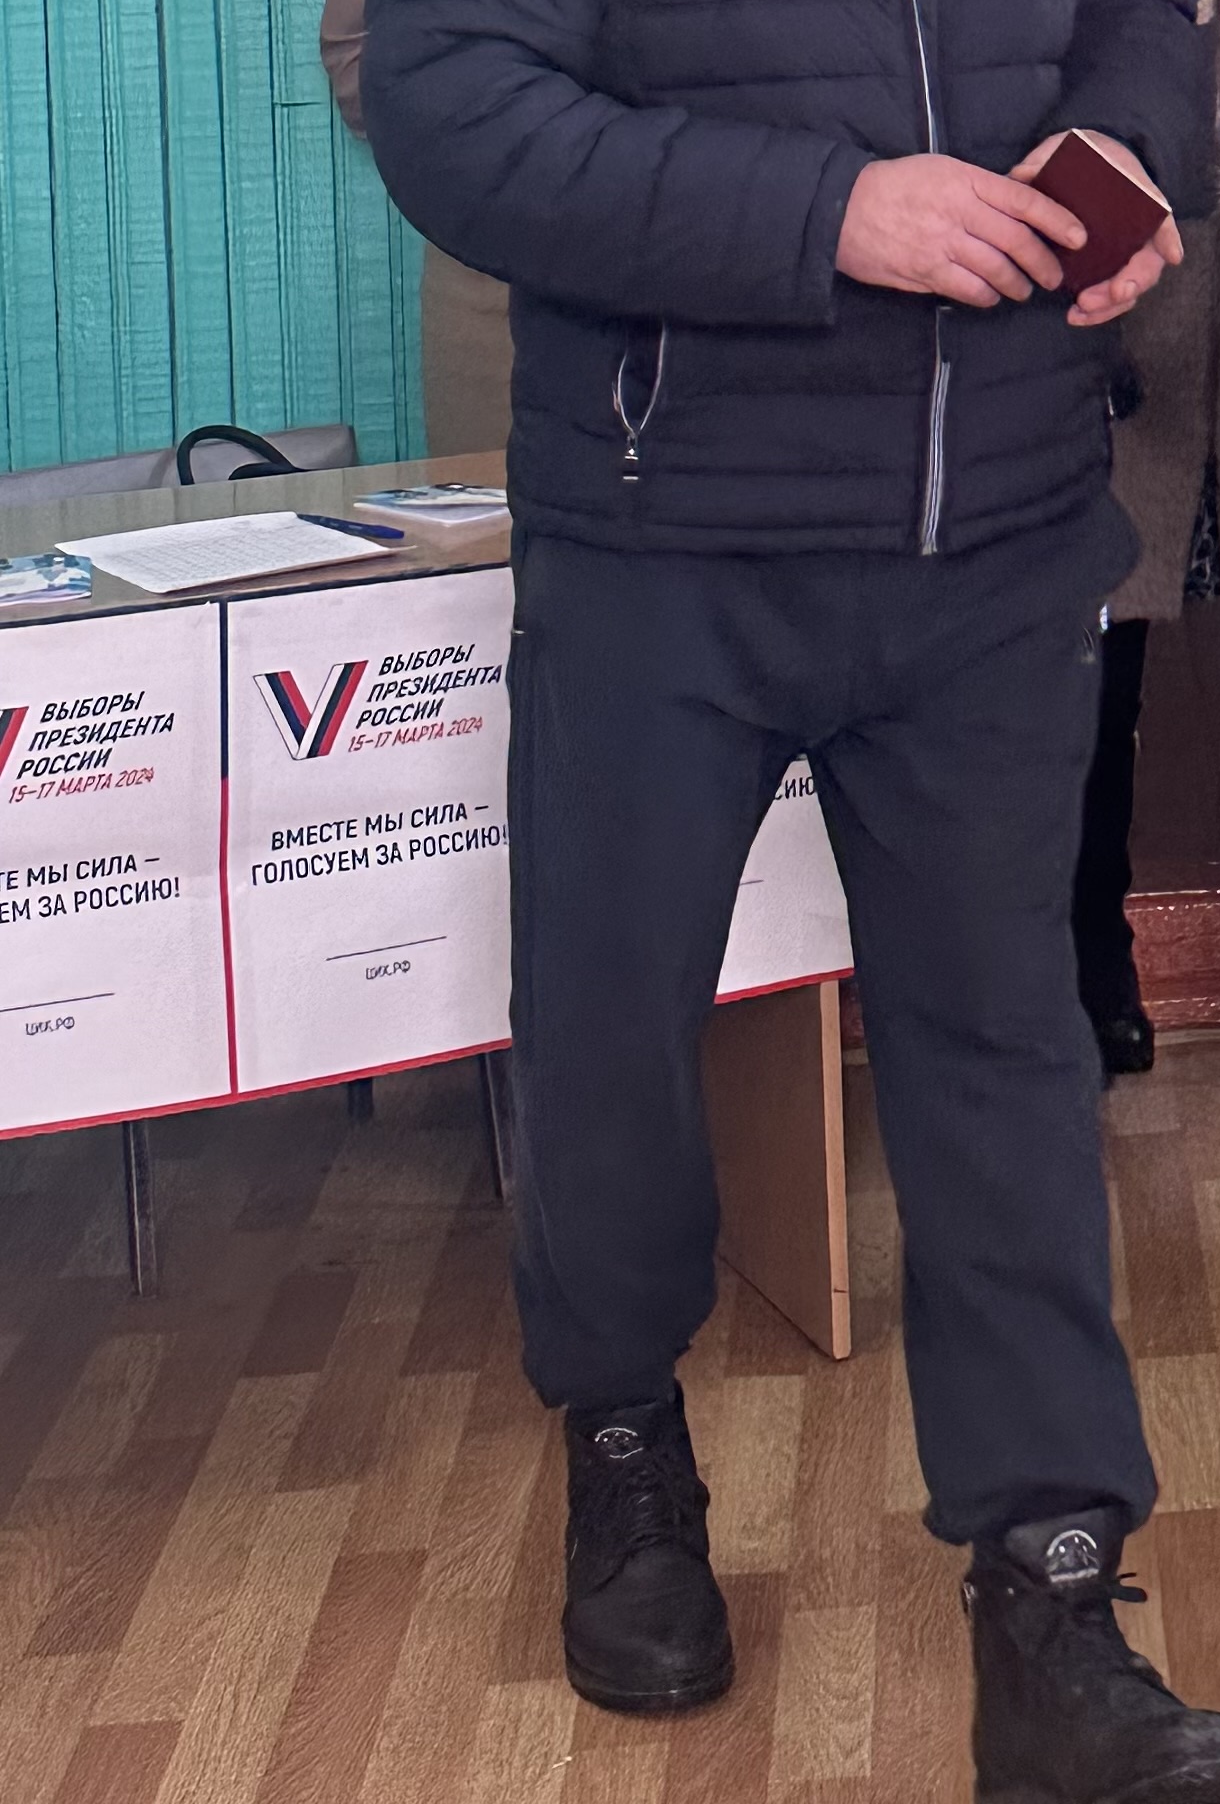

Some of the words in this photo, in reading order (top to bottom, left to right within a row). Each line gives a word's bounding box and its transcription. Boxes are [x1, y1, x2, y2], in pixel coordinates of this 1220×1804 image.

[379, 643, 476, 676] ВЫБОРЫ
[366, 664, 503, 703] ПРЕЗИДЕНТА
[40, 691, 146, 724] ВЫБОРЫ
[355, 697, 445, 729] РОССИИ
[28, 712, 175, 752] ПРЕЗИДЕНТА
[392, 722, 444, 747] МАРТА
[447, 716, 483, 737] 2024
[16, 747, 113, 780] РОССИИ
[55, 772, 113, 797] МАРТА
[115, 766, 155, 788] 2024
[774, 776, 815, 800] ИЮ
[271, 819, 358, 851] ВМЕСТЕ
[365, 812, 404, 836] МЫ
[411, 802, 468, 828] СИЛА
[27, 863, 69, 888] МЫ
[76, 854, 137, 881] СИЛА
[251, 847, 369, 886] ГОЛОСУЕМ
[376, 842, 404, 866] ЗА
[409, 824, 508, 860] РОССИЮ!
[38, 893, 67, 918] ЗА
[74, 877, 180, 913] РОССИЮ!
